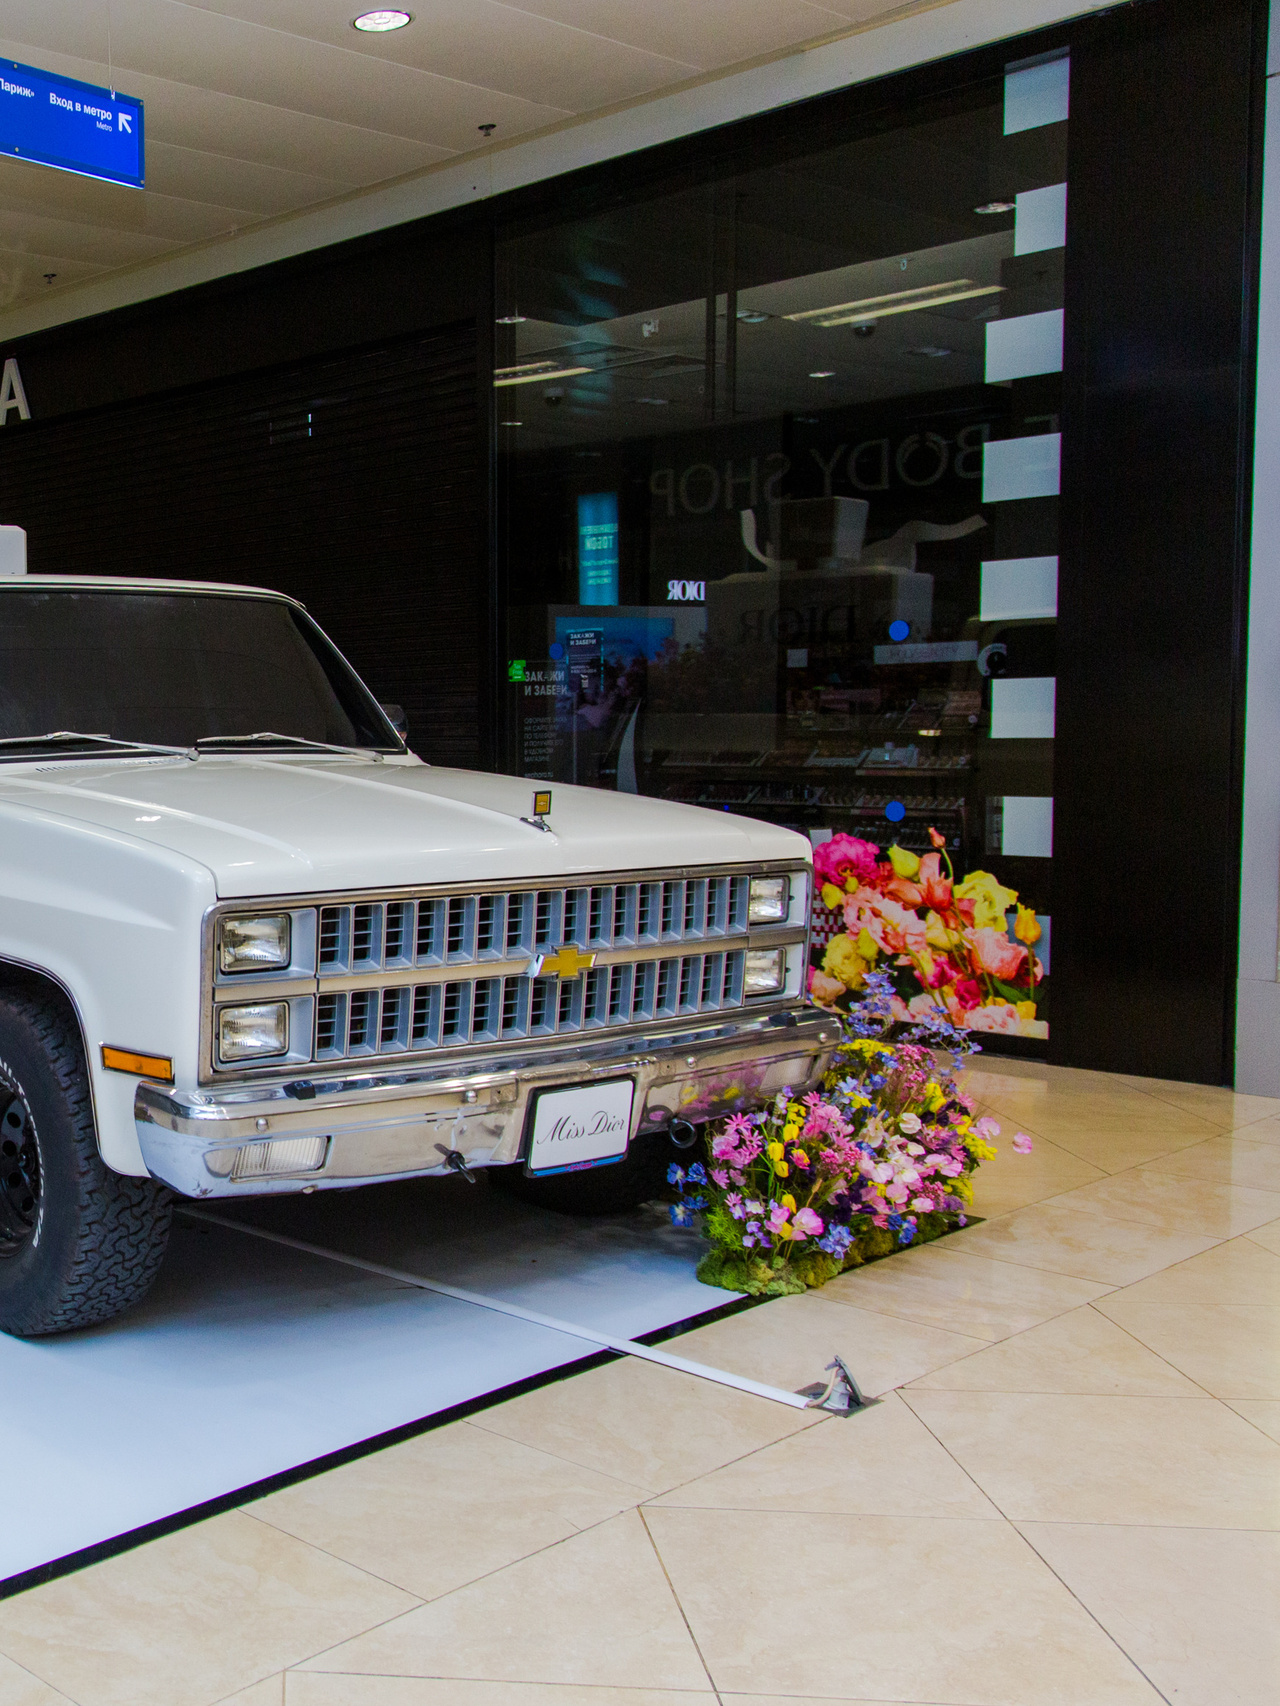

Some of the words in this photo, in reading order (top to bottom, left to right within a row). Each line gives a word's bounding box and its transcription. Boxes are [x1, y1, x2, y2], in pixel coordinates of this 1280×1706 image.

[49, 93, 73, 112] Вход
[75, 101, 82, 112] в
[83, 103, 112, 121] метро
[96, 121, 113, 132] Metro
[525, 686, 531, 696] И
[537, 1115, 585, 1145] Miss
[588, 1110, 625, 1136] Dior
